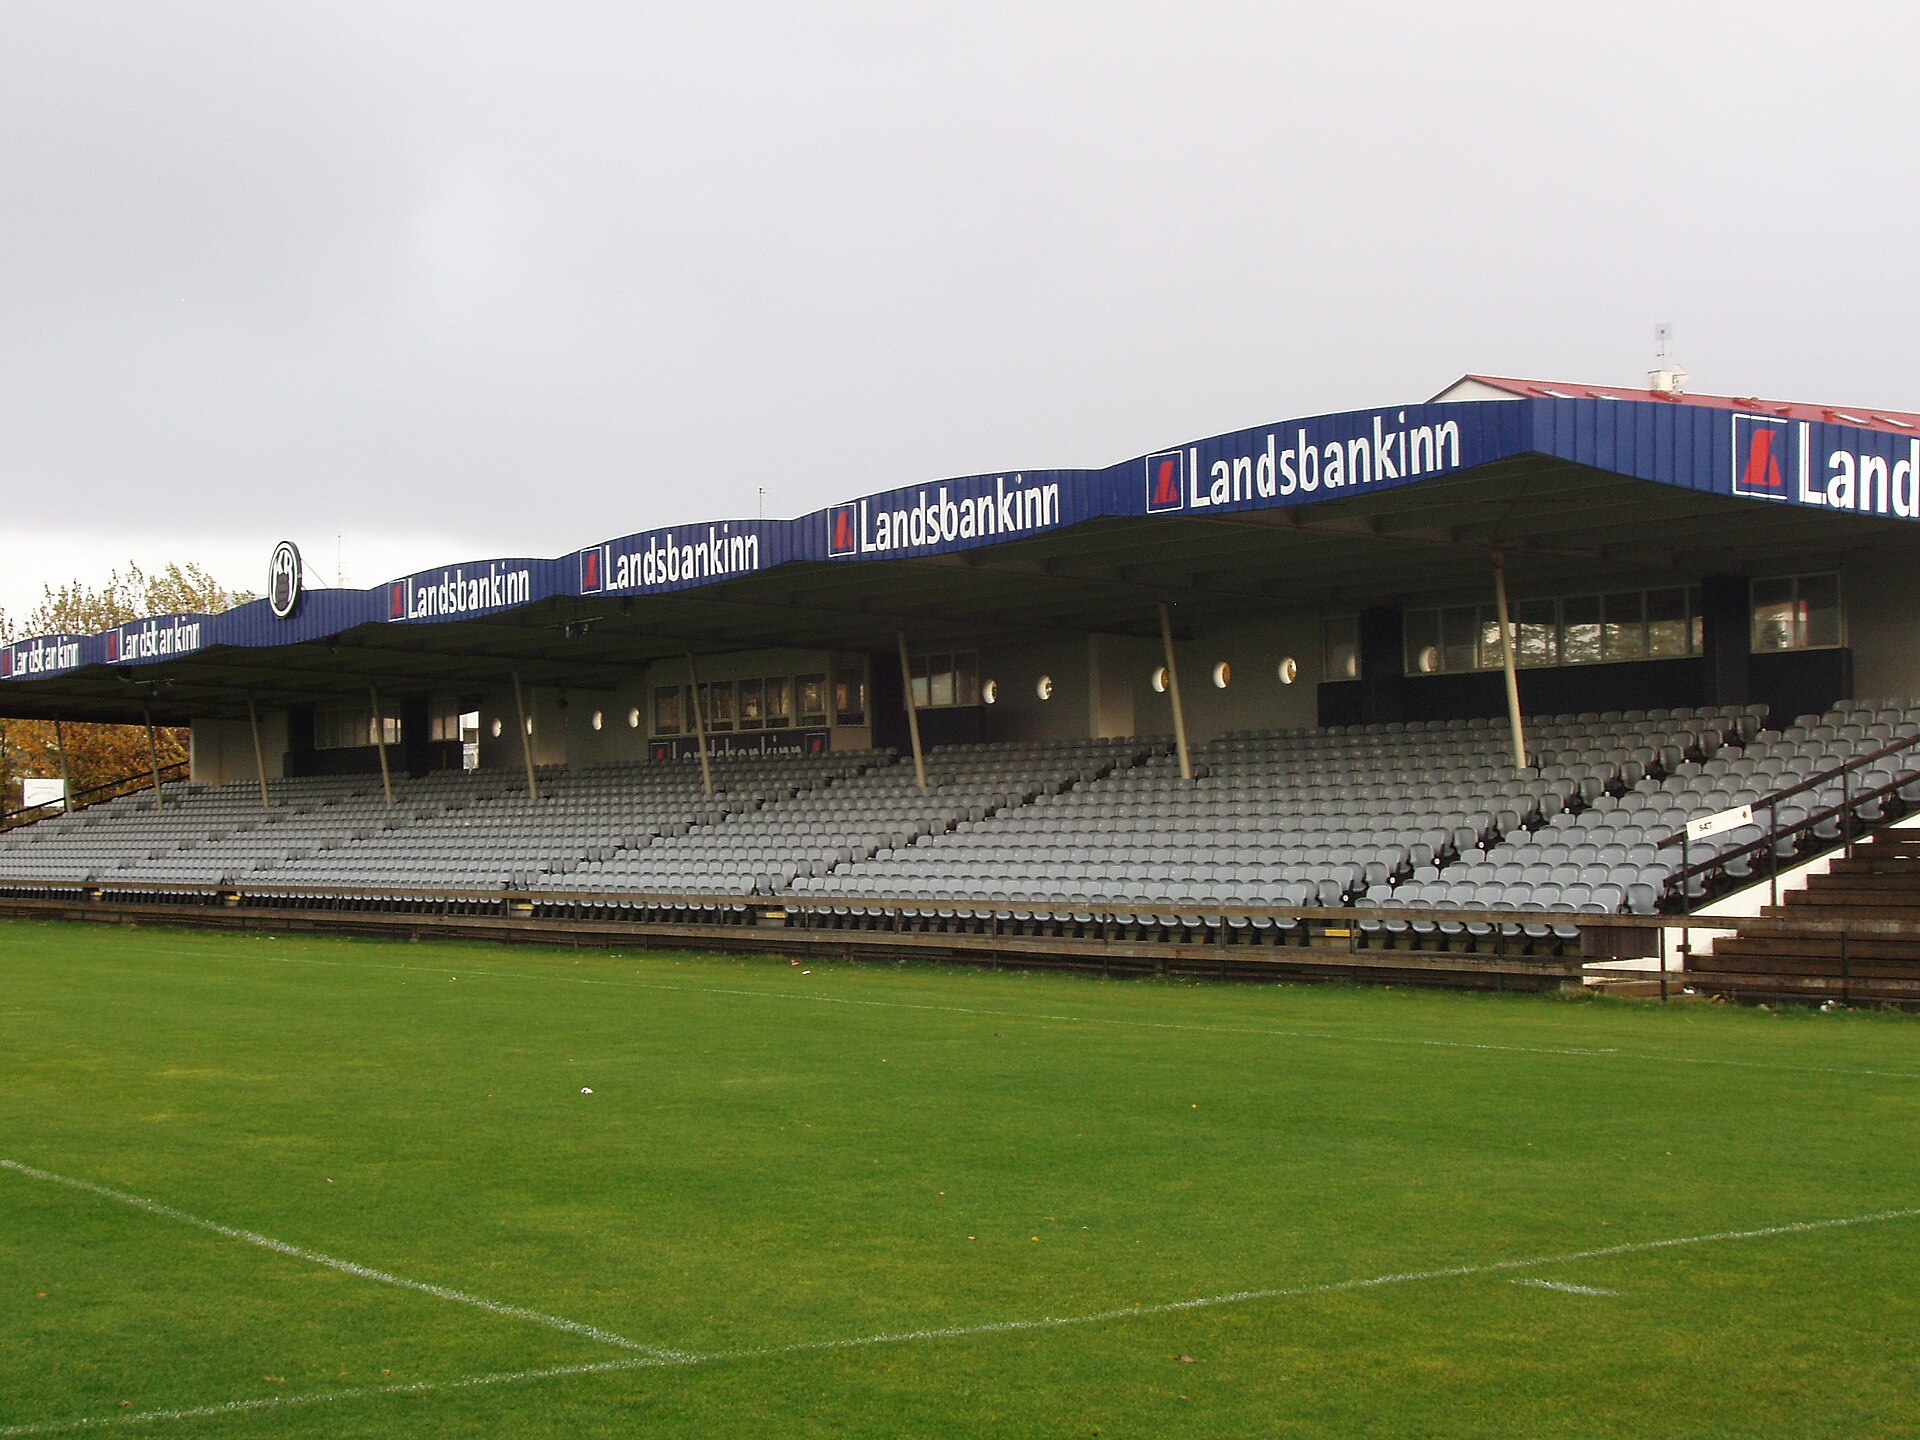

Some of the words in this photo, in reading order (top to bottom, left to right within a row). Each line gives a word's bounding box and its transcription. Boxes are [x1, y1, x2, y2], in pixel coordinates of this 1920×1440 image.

[1189, 411, 1460, 507] Landsbankinn
[1799, 421, 1920, 518] Land
[860, 473, 1059, 553] Landsbankinn
[407, 562, 530, 619] Landsbankinn
[605, 523, 759, 591] Landsbankinn
[119, 616, 200, 661] Landsbankinn
